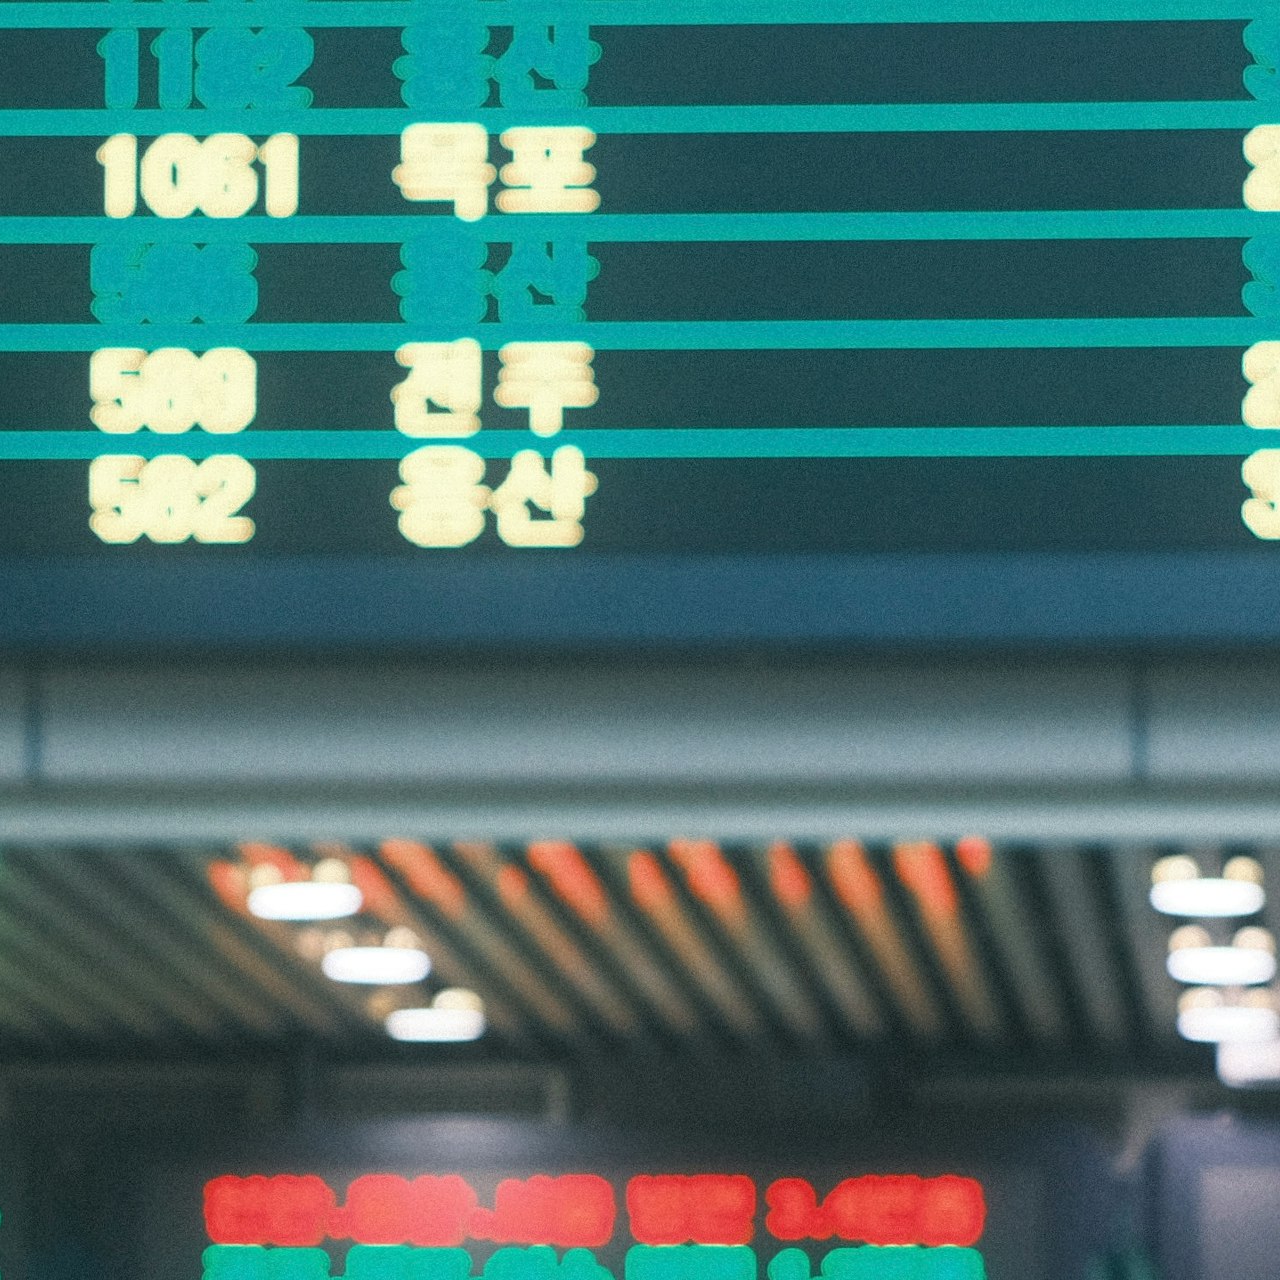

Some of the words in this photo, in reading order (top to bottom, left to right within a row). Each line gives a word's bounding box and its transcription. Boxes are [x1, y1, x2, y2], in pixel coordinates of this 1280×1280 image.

[97, 133, 299, 218] 1061
[392, 122, 601, 222] 목포
[391, 339, 599, 438] 전주
[390, 446, 598, 547] 용산
